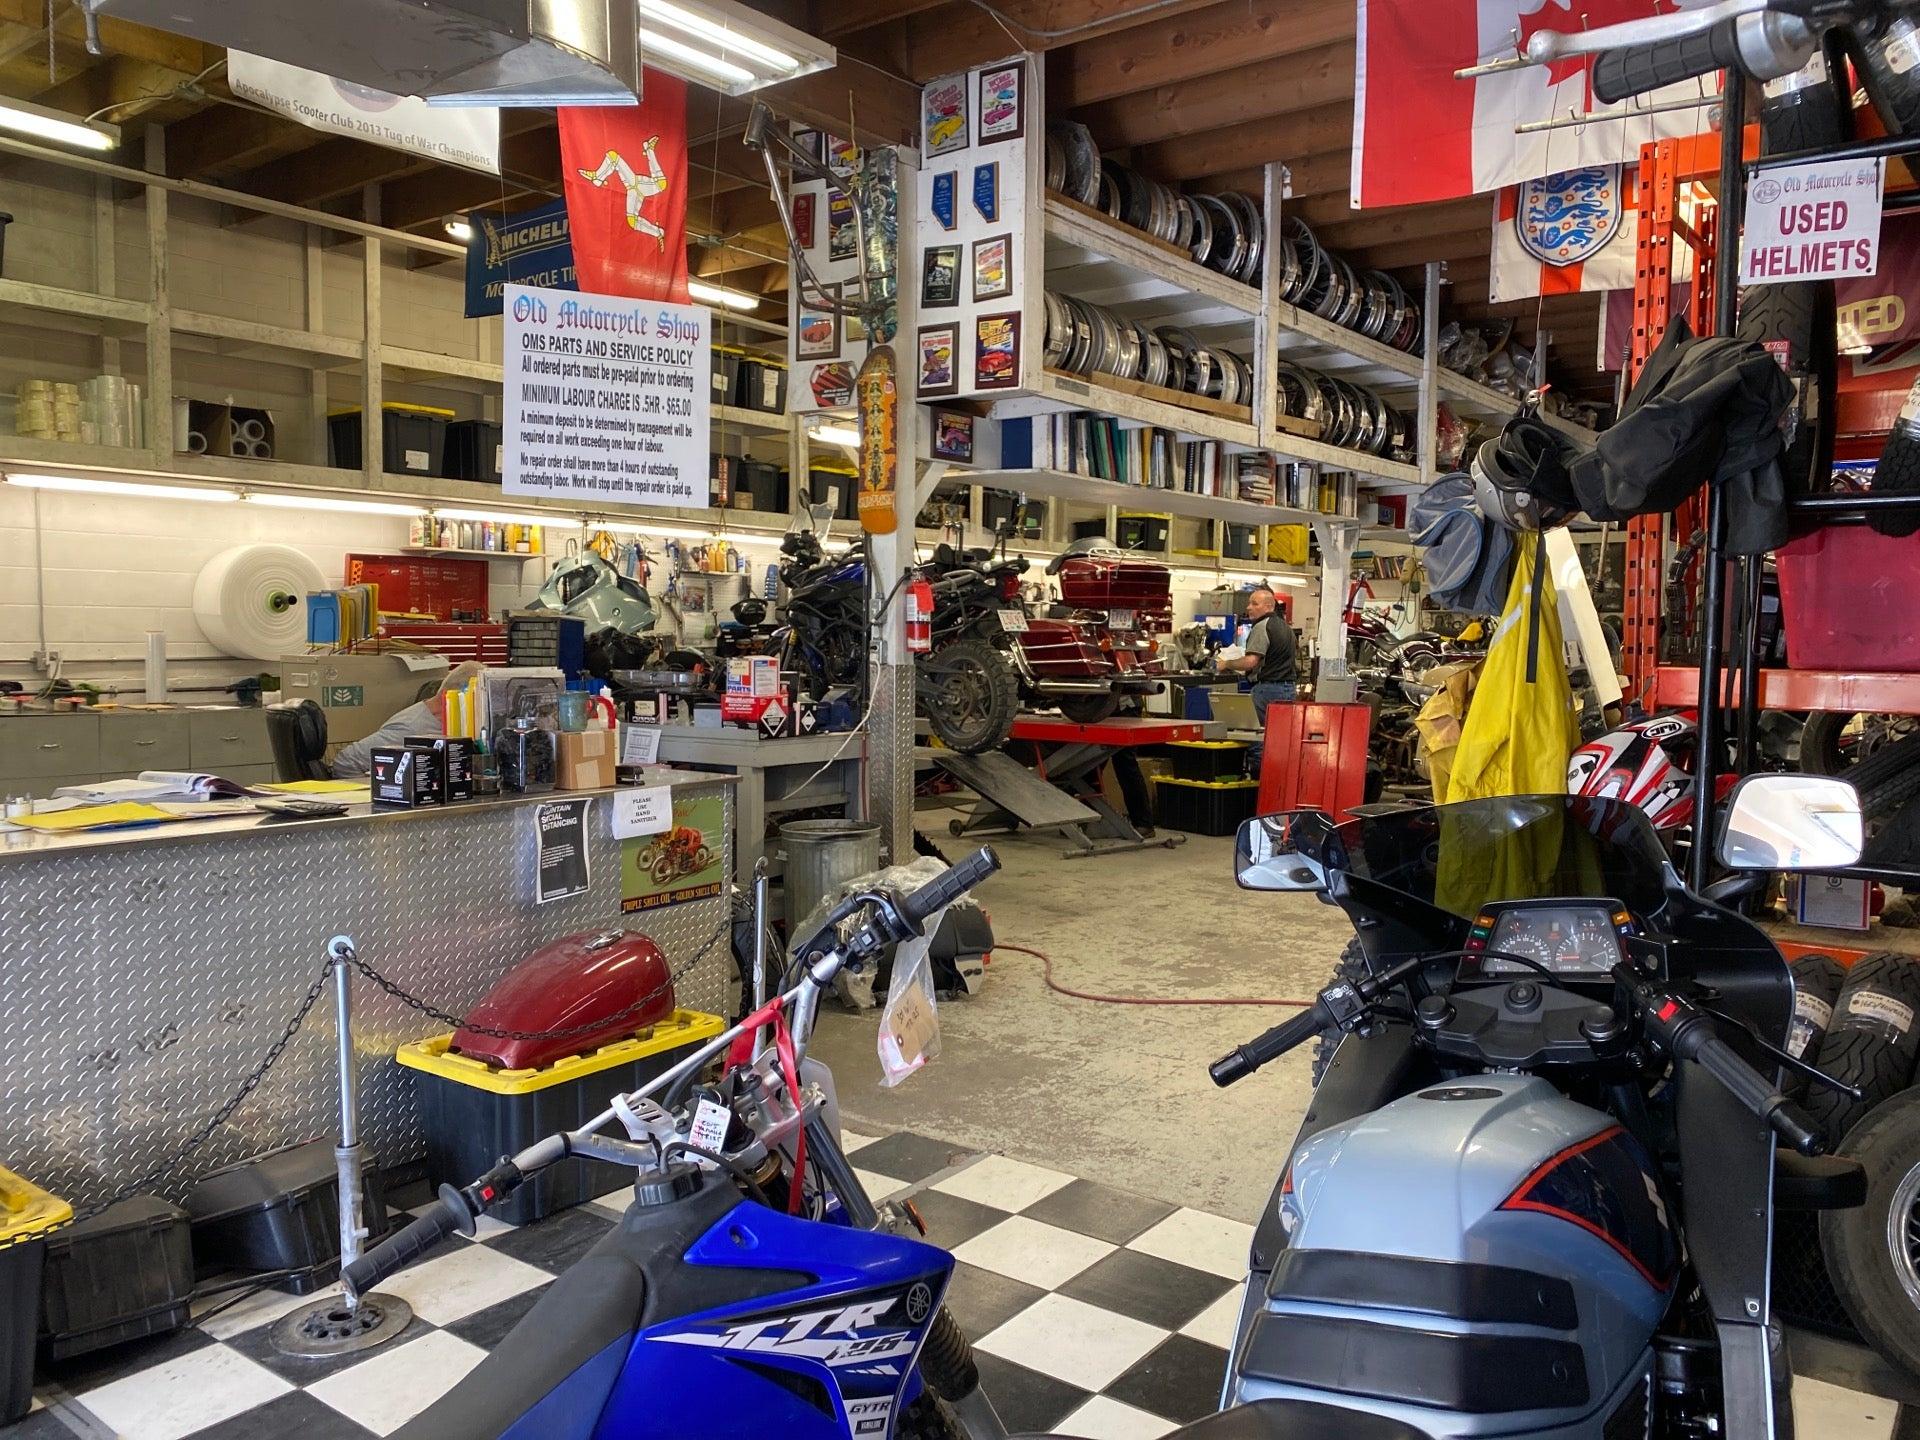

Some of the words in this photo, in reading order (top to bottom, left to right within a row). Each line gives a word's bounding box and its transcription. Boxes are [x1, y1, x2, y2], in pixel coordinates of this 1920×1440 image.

[235, 78, 291, 111] Apocalypse
[293, 98, 328, 122] Scooter
[330, 112, 354, 129] Club
[356, 119, 382, 136] 2013
[384, 128, 402, 145] Tug
[404, 134, 416, 144] of
[416, 136, 436, 150] War
[438, 142, 490, 166] Champions
[1784, 176, 1800, 192] Old
[1804, 172, 1852, 192] Motorcycle
[1780, 201, 1848, 235] USED
[501, 218, 569, 250] MICHELI
[1750, 239, 1870, 277] HELMETS
[486, 270, 558, 298] MOCYCLE
[513, 294, 547, 324] Old
[556, 300, 648, 338] Motorcycle
[656, 310, 700, 346] Shop
[1837, 295, 1905, 336] TED
[522, 333, 546, 350] OMS
[550, 336, 582, 354] PARTS
[586, 340, 607, 356] AND
[610, 342, 654, 361] SERVICE
[656, 347, 693, 366] POLICY
[522, 355, 532, 372] All
[534, 359, 560, 375] ordered
[562, 363, 580, 380] parts
[582, 366, 600, 379] must
[602, 366, 610, 380] be
[611, 366, 639, 385] pre-paid
[640, 370, 656, 384] prior
[658, 371, 664, 384] to
[666, 372, 694, 392] ordering
[522, 383, 560, 404] MINIMUM
[562, 387, 596, 408] LABOUR
[598, 391, 631, 410] CHARGE
[632, 394, 640, 412] IS
[666, 397, 692, 416] $65.00
[520, 410, 526, 424] A
[526, 412, 554, 426] minimum
[555, 414, 577, 430] deposit
[579, 416, 584, 428] to
[586, 415, 593, 429] be
[594, 416, 628, 432] determined
[628, 418, 636, 434] by
[636, 422, 673, 438] management
[674, 423, 684, 436] will
[685, 424, 692, 438] be
[520, 430, 546, 446] required
[547, 433, 554, 444] on
[555, 431, 563, 445] all
[564, 432, 579, 446] work
[580, 434, 610, 452] exceeding
[612, 438, 622, 448] one
[624, 436, 636, 450] hour
[638, 437, 644, 451] of
[644, 438, 664, 453] labour.
[520, 452, 528, 466] No
[530, 452, 546, 468] repair
[548, 454, 562, 468] order
[564, 454, 576, 469] shall
[578, 456, 590, 470] have
[592, 460, 606, 472] more
[607, 458, 618, 471] than
[620, 459, 624, 472] 4
[625, 460, 640, 473] hours
[641, 461, 646, 475] of
[648, 462, 678, 480] outstanding
[520, 472, 552, 489] outstanding
[554, 473, 570, 487] labor.
[572, 474, 586, 488] Work
[588, 475, 597, 488] will
[598, 477, 610, 492] stop
[611, 478, 624, 490] until
[624, 478, 634, 490] the
[634, 480, 650, 494] repair
[651, 481, 665, 494] order
[666, 482, 671, 494] is
[672, 482, 684, 498] paid
[684, 485, 692, 498] up.
[632, 796, 652, 804] PLEASE
[542, 817, 578, 831] DSTANCING
[630, 816, 656, 824] SANITIZER
[623, 900, 642, 912] TRIPLE
[644, 896, 660, 908] SHELL
[660, 894, 670, 904] OIL
[676, 890, 694, 901] GOLDEN
[696, 886, 710, 897] SHELL
[711, 884, 720, 894] OIL
[720, 1298, 898, 1350] TTR
[850, 1401, 891, 1415] GYTR
